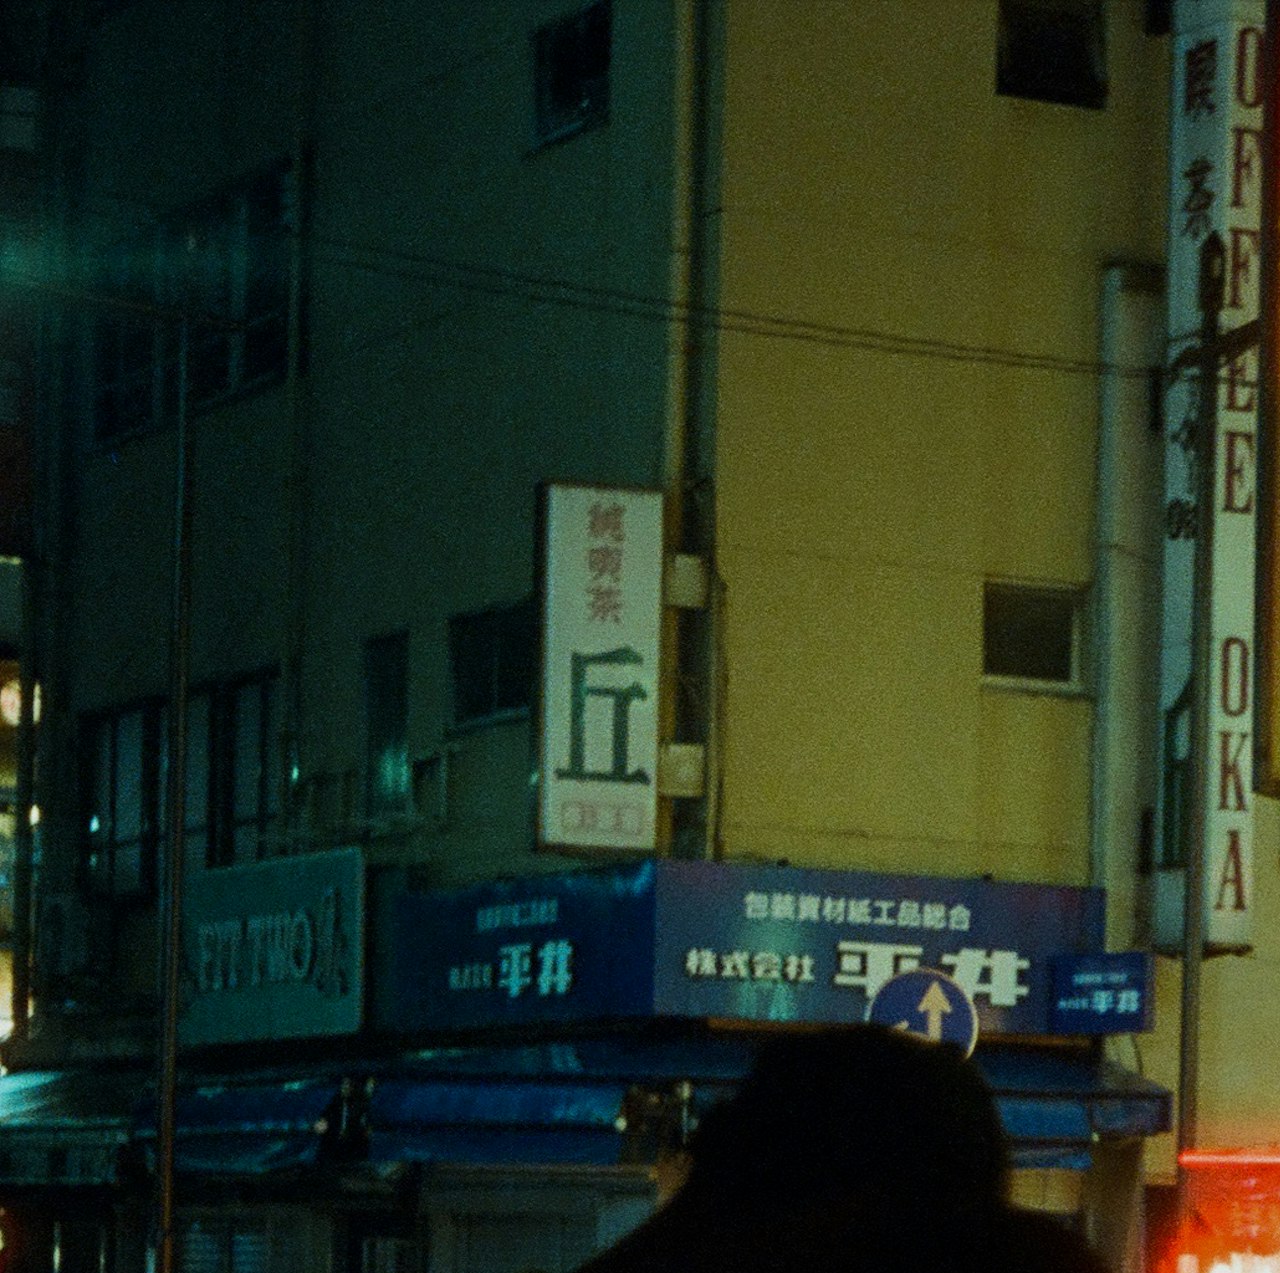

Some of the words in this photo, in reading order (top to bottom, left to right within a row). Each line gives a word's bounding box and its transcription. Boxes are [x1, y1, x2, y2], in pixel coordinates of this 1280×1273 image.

[1215, 637, 1251, 911] OKA
[498, 938, 574, 998] 平井
[685, 947, 815, 984] 株式会社
